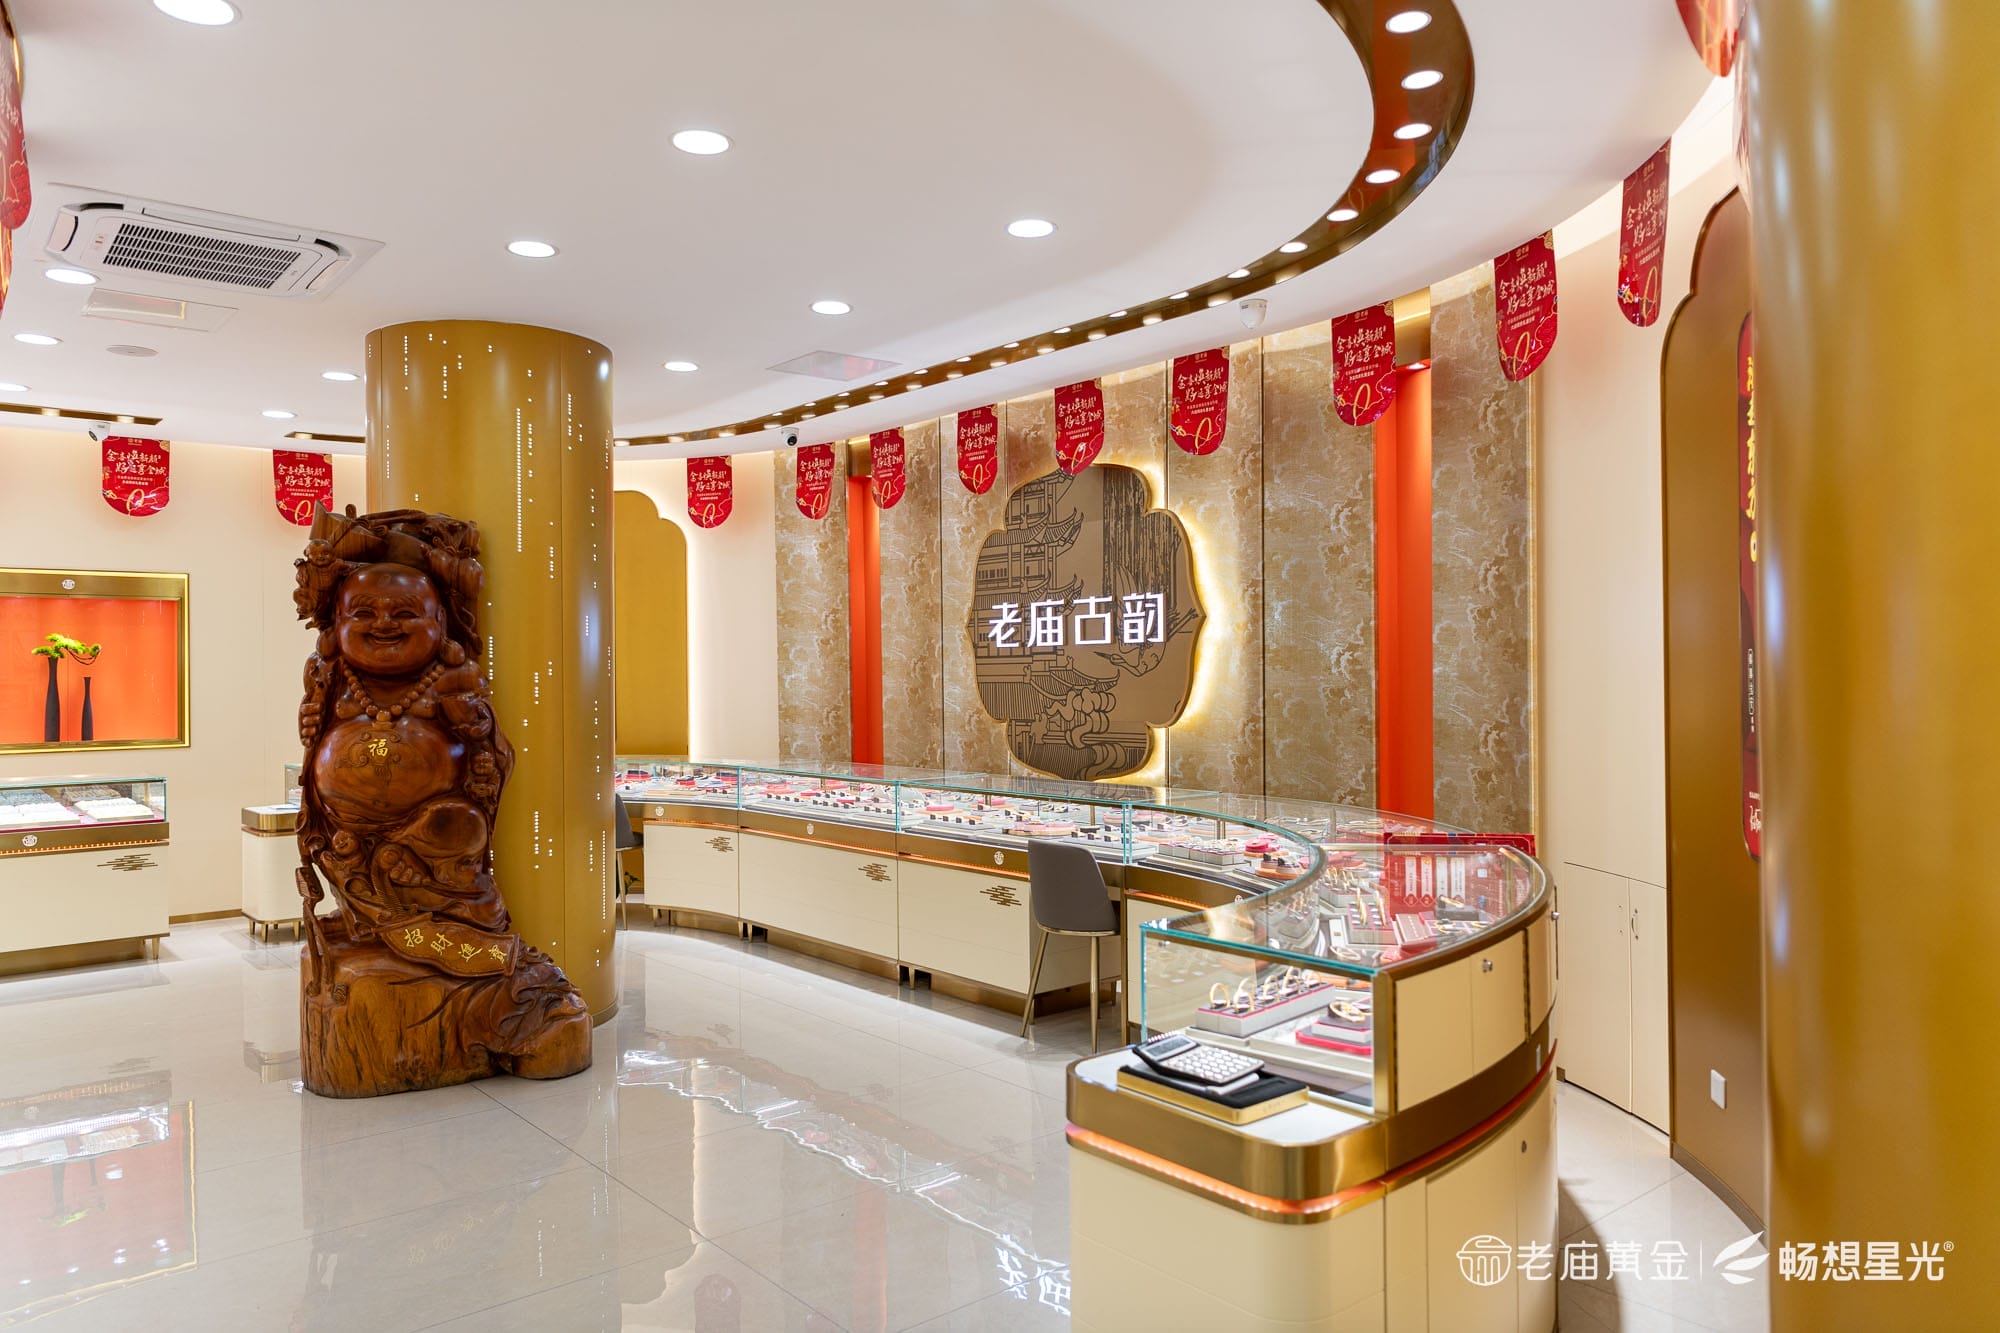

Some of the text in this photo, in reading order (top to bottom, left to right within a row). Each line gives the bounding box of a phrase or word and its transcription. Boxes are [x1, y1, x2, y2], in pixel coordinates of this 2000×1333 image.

[988, 592, 1167, 648] 老庙古韵
[368, 738, 388, 757] 福
